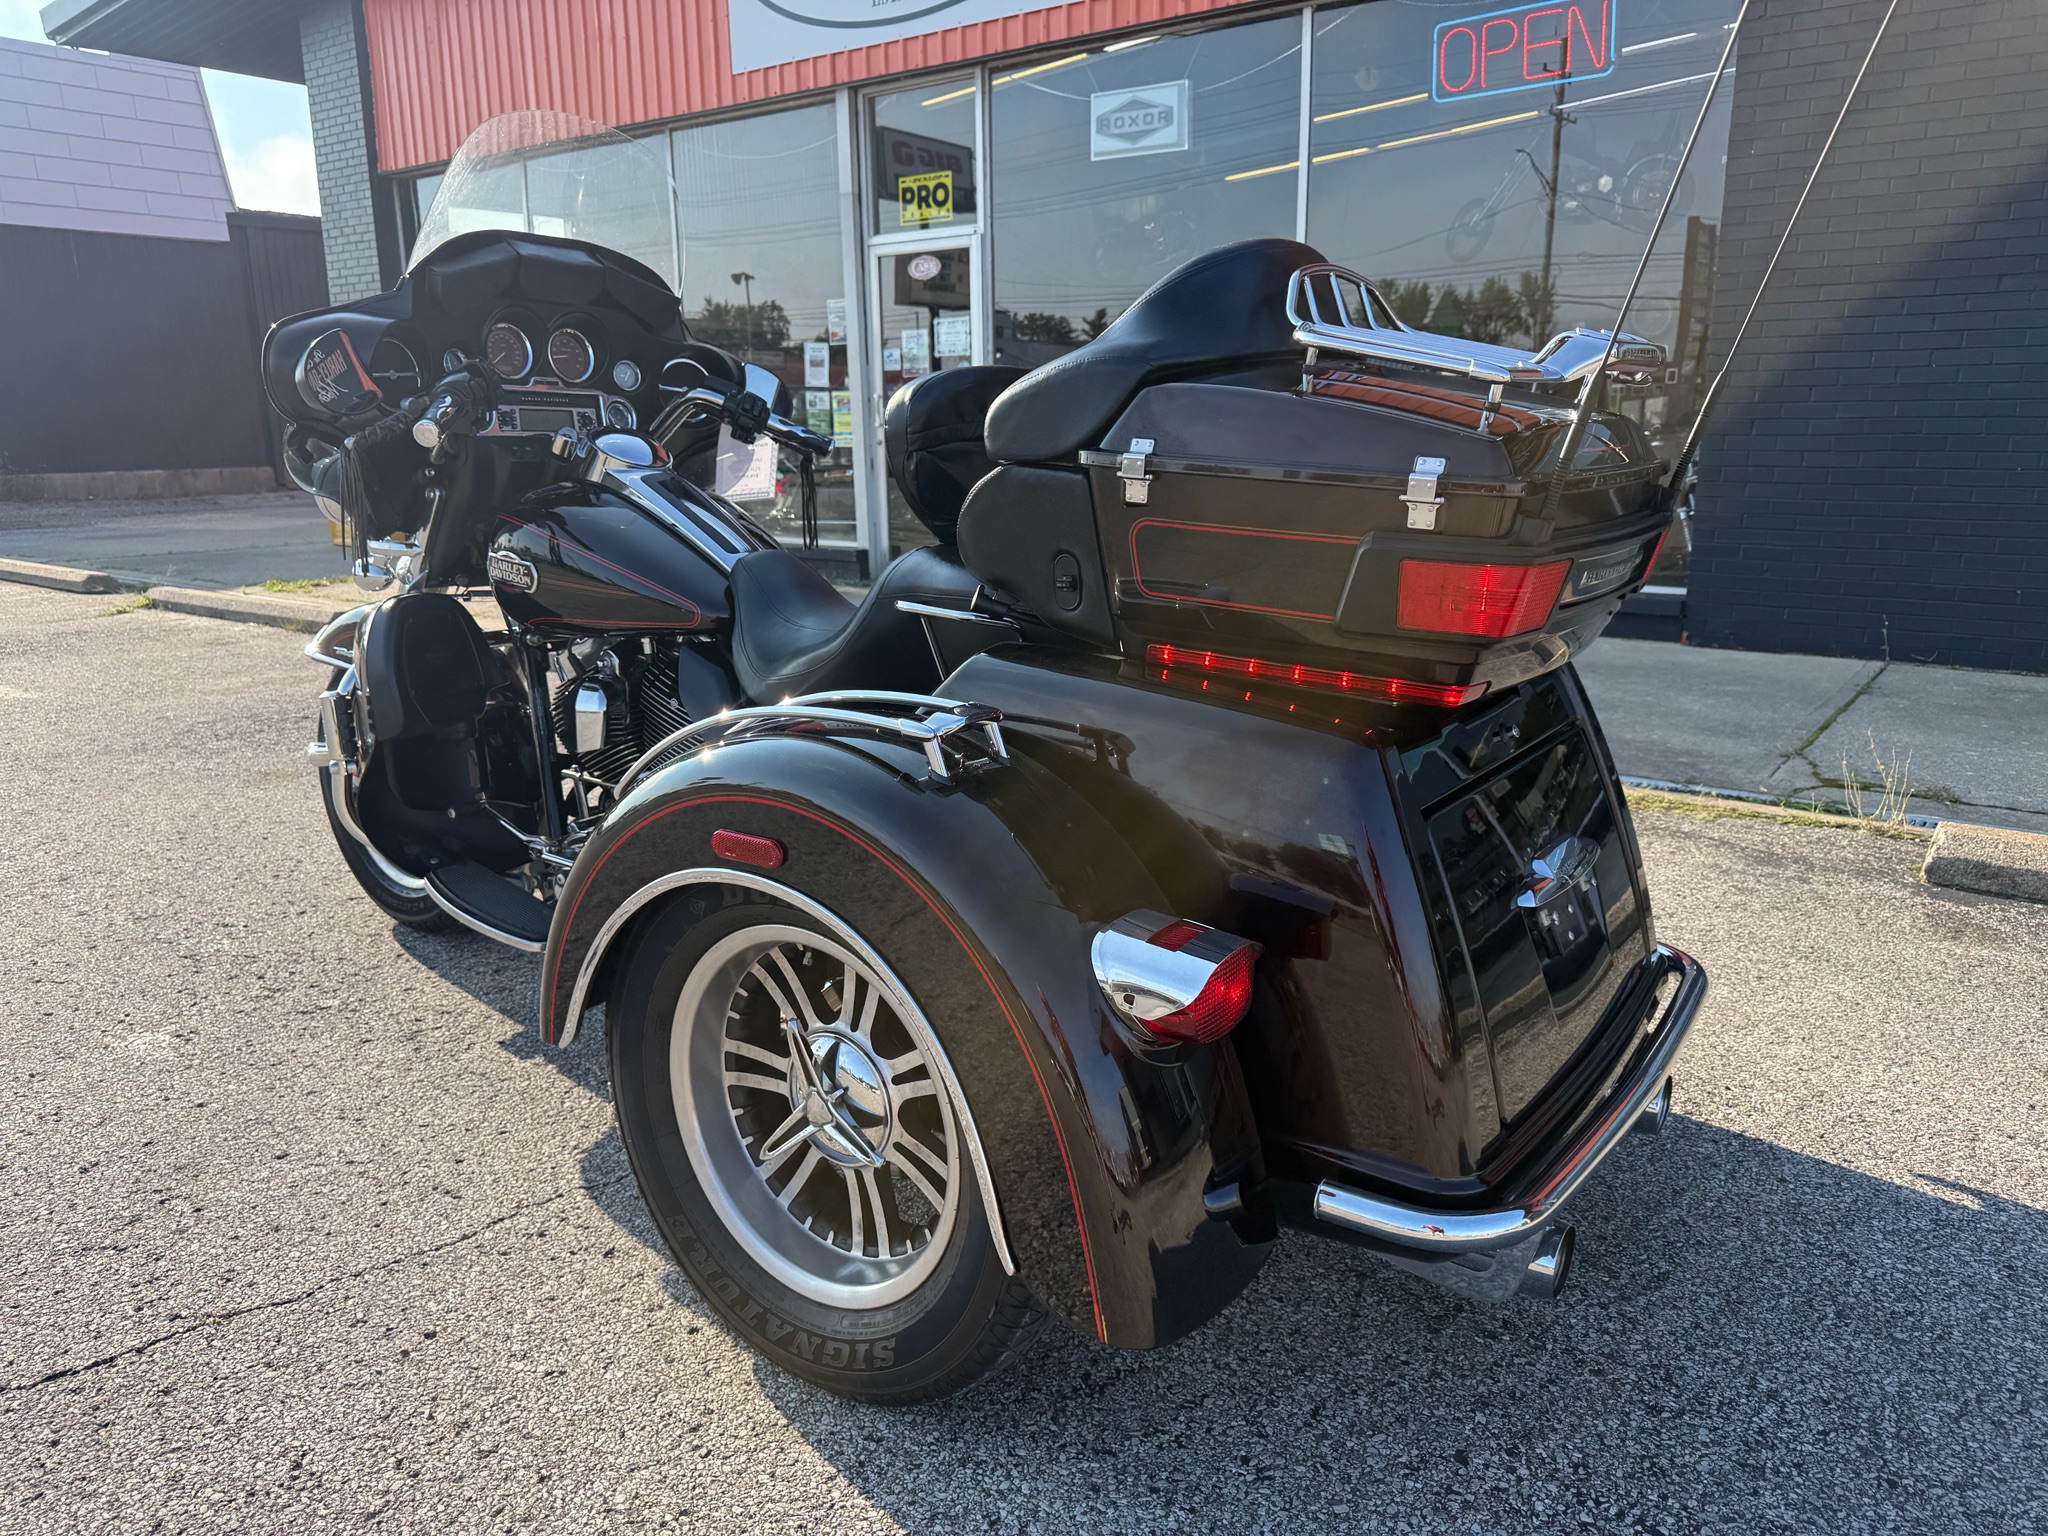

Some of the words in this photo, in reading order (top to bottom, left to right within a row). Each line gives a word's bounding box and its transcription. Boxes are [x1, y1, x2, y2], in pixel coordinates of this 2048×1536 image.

[1440, 0, 1608, 92] OPEN
[1100, 110, 1169, 130] ROXOR
[901, 182, 950, 212] PRO
[490, 566, 531, 586] DAVIDSON
[491, 557, 528, 575] HARLEY-
[667, 1213, 897, 1370] SIGNATURE
